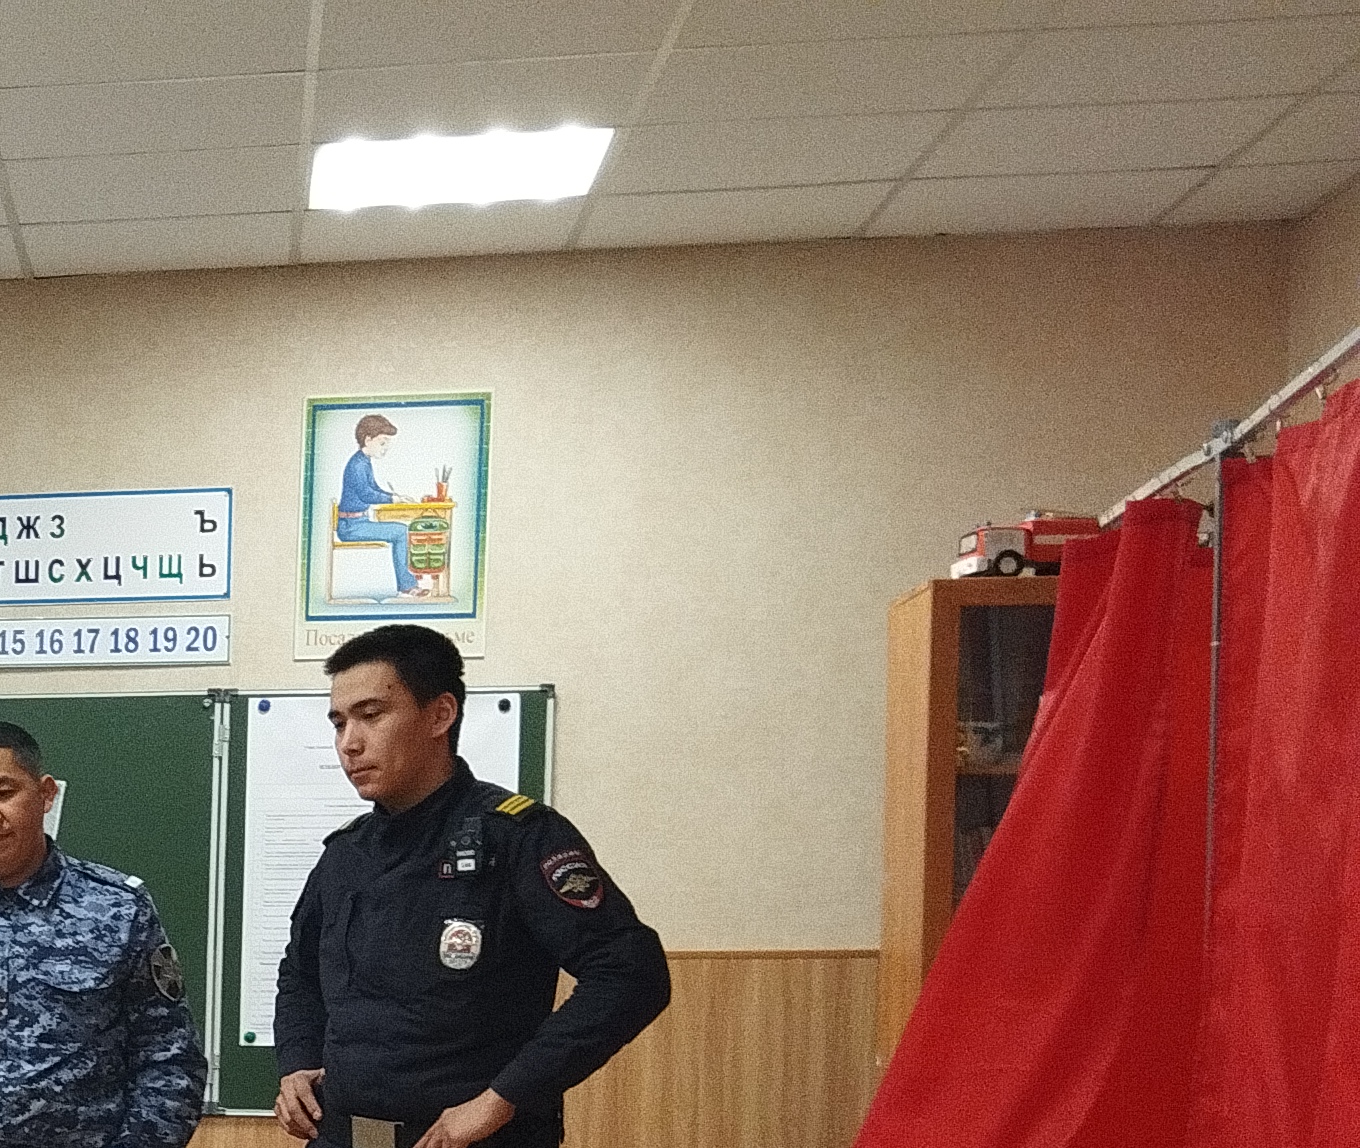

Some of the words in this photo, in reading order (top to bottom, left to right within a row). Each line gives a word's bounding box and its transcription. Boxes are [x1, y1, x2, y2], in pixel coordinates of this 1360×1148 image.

[34, 628, 63, 654] 16
[72, 628, 100, 654] 17
[109, 627, 139, 653] 18
[148, 626, 177, 652] 19
[185, 625, 217, 652] 20
[306, 628, 351, 645] Поса
